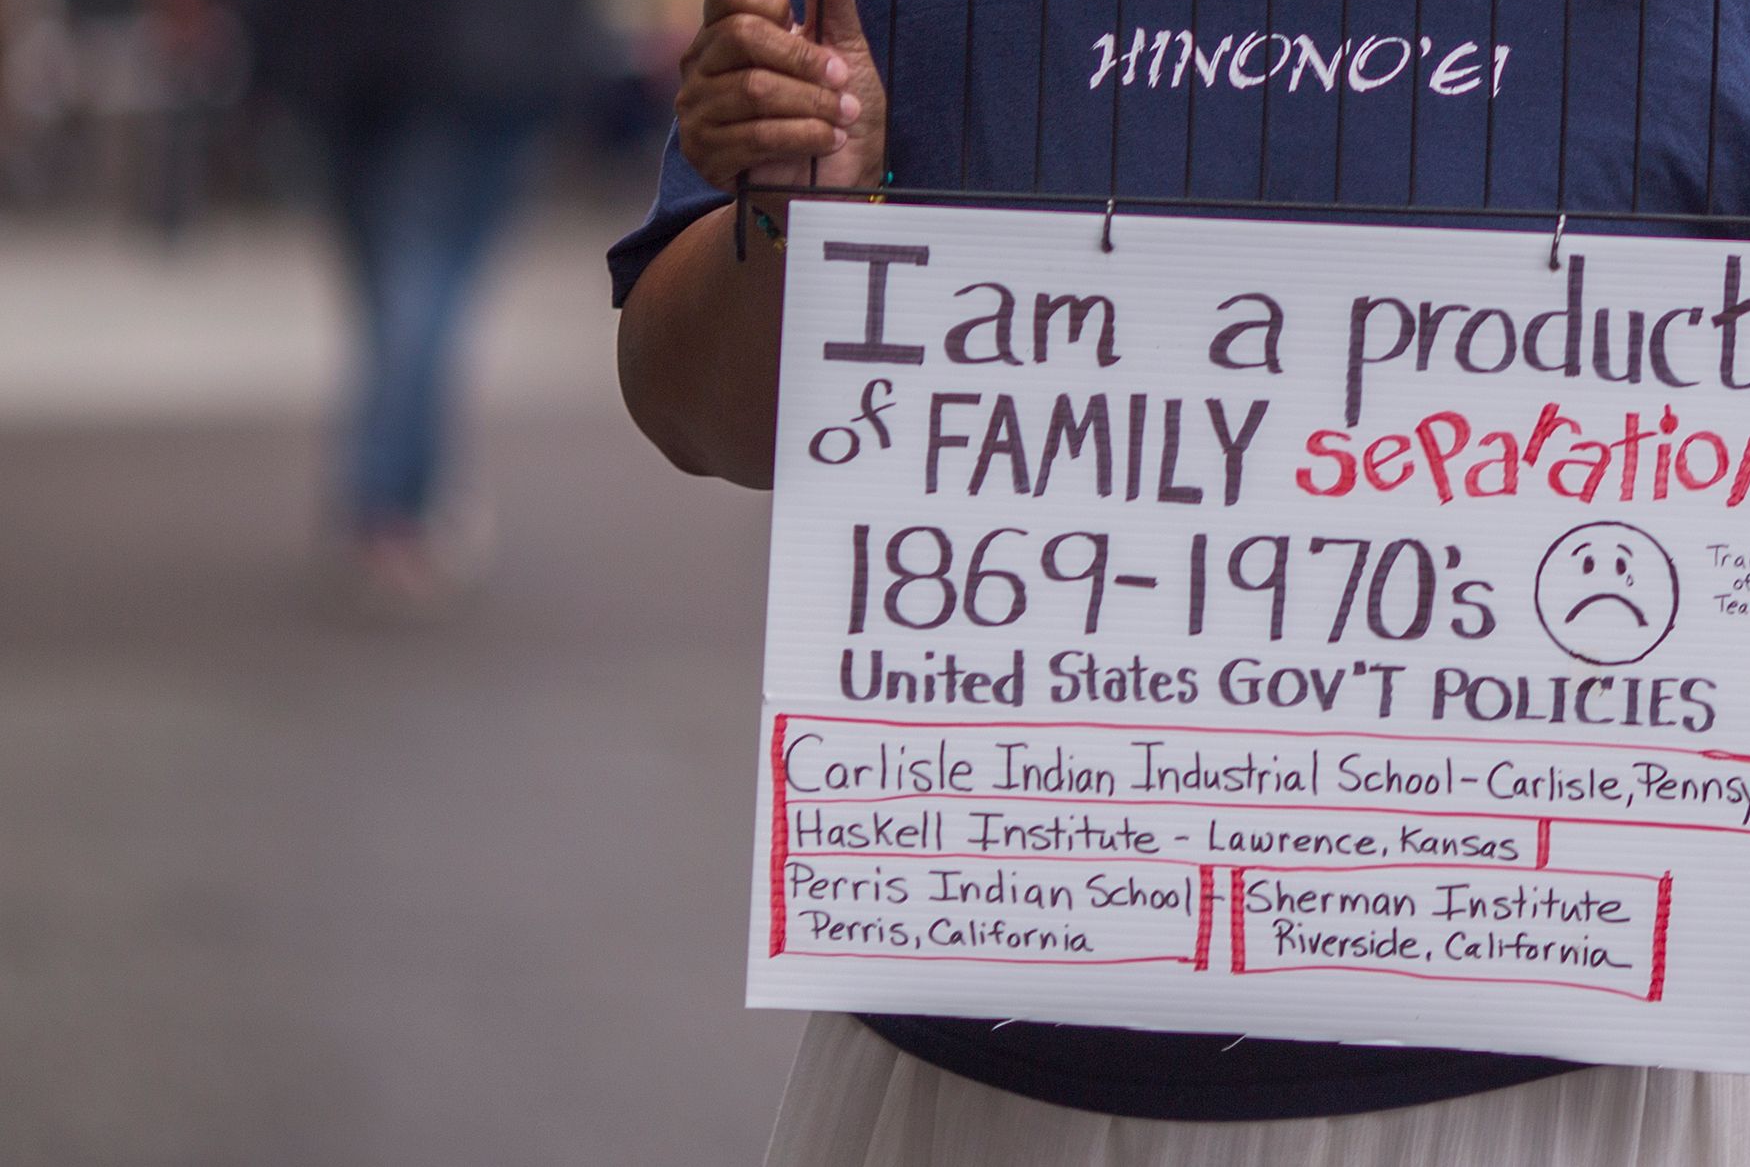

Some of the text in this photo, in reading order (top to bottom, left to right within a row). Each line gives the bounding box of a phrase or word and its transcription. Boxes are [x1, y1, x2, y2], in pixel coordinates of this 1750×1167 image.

[824, 241, 929, 365] I
[944, 282, 1121, 368] am
[1209, 292, 1283, 374] a
[808, 378, 896, 465] of
[925, 393, 1269, 506] FAMILY
[847, 524, 1497, 643] 1869-1970's
[840, 649, 1717, 732] United States GOV'T POLICIES
[785, 733, 974, 793] Carlisle
[992, 742, 1114, 797] Indian
[1131, 741, 1318, 797] Industrial
[795, 809, 942, 850] Haskell
[968, 812, 1159, 852] Institute
[1210, 820, 1387, 858] Lawrence,
[1401, 823, 1519, 861] Kansas
[785, 862, 1192, 913] Perris Indian School
[1246, 879, 1630, 924] Sherman Institute
[798, 910, 1094, 953] Perris, California
[1272, 918, 1633, 970] Riverside, California
